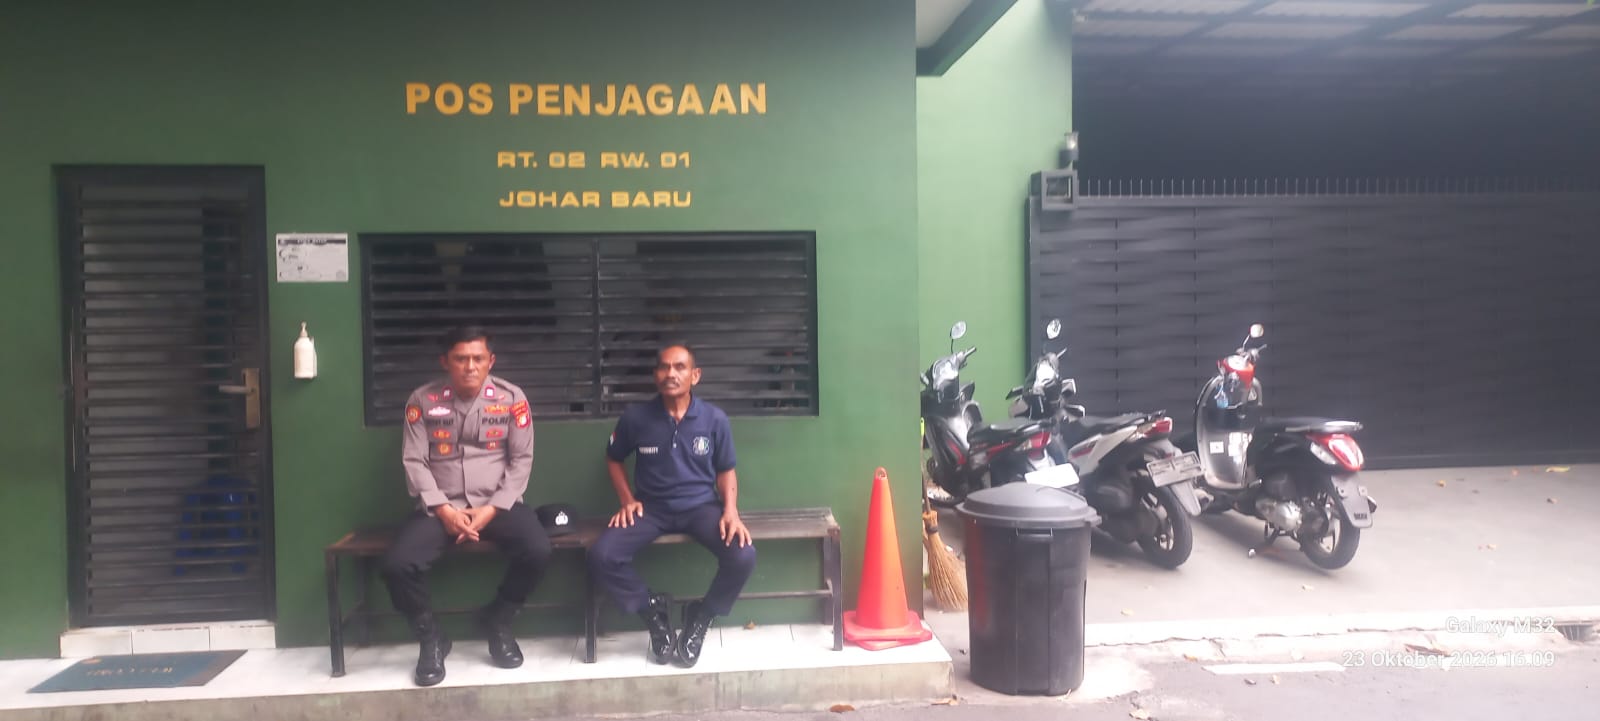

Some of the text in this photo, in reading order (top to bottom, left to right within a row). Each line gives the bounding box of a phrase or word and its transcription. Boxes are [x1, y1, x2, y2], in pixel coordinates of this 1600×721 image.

[405, 82, 768, 117] POS PENJAGAAN
[497, 151, 692, 169] RT. 02 RW. 01
[499, 190, 693, 209] JOHAR BARU
